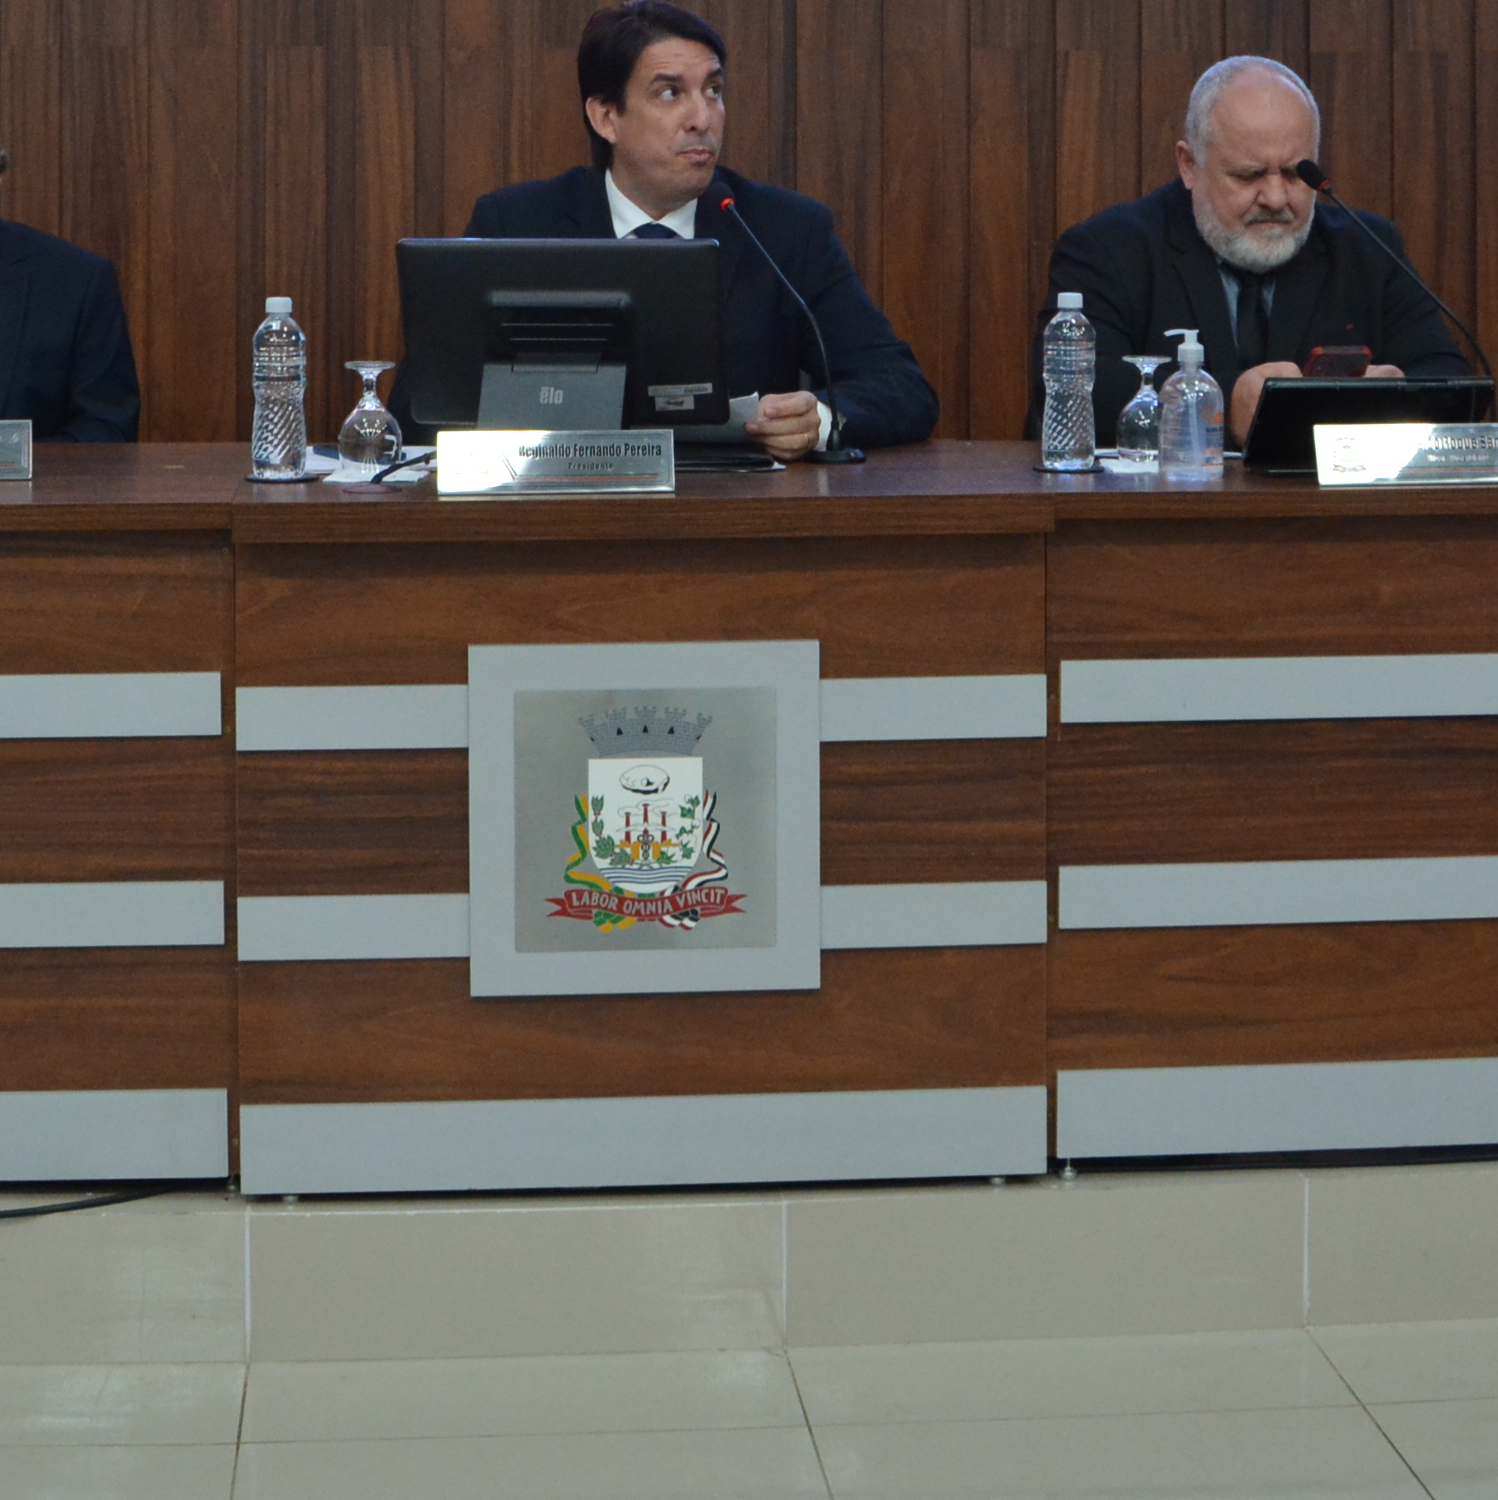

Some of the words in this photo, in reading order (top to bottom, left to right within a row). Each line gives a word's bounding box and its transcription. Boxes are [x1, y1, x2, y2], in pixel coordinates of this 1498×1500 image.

[573, 443, 622, 458] Fernando
[624, 442, 662, 457] Pereira
[571, 890, 619, 911] LABOR
[623, 899, 674, 916] OMNIA
[675, 888, 726, 909] VINCIT
